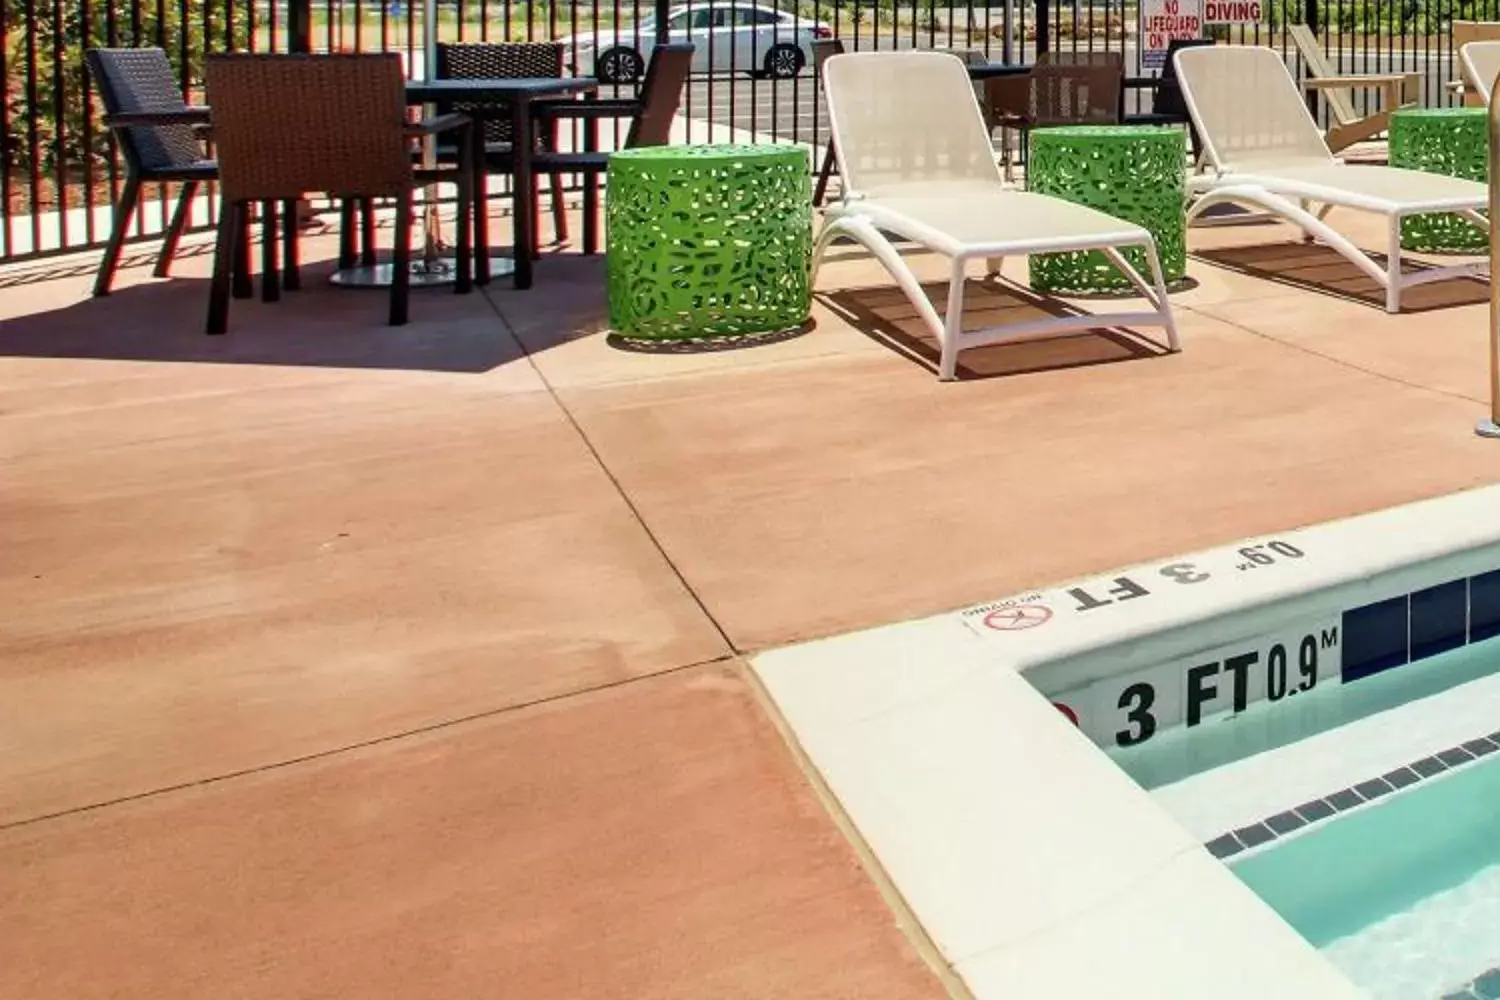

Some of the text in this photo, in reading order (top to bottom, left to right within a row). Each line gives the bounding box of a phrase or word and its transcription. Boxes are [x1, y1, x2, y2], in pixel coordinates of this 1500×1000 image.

[1164, 0, 1179, 14] NO
[1205, 2, 1261, 21] DIVING
[1144, 15, 1199, 32] LIFEGUARD
[1149, 34, 1163, 48] ON
[1066, 563, 1211, 612] 3 FT
[1115, 682, 1156, 747] 3
[1186, 651, 1259, 728] FT
